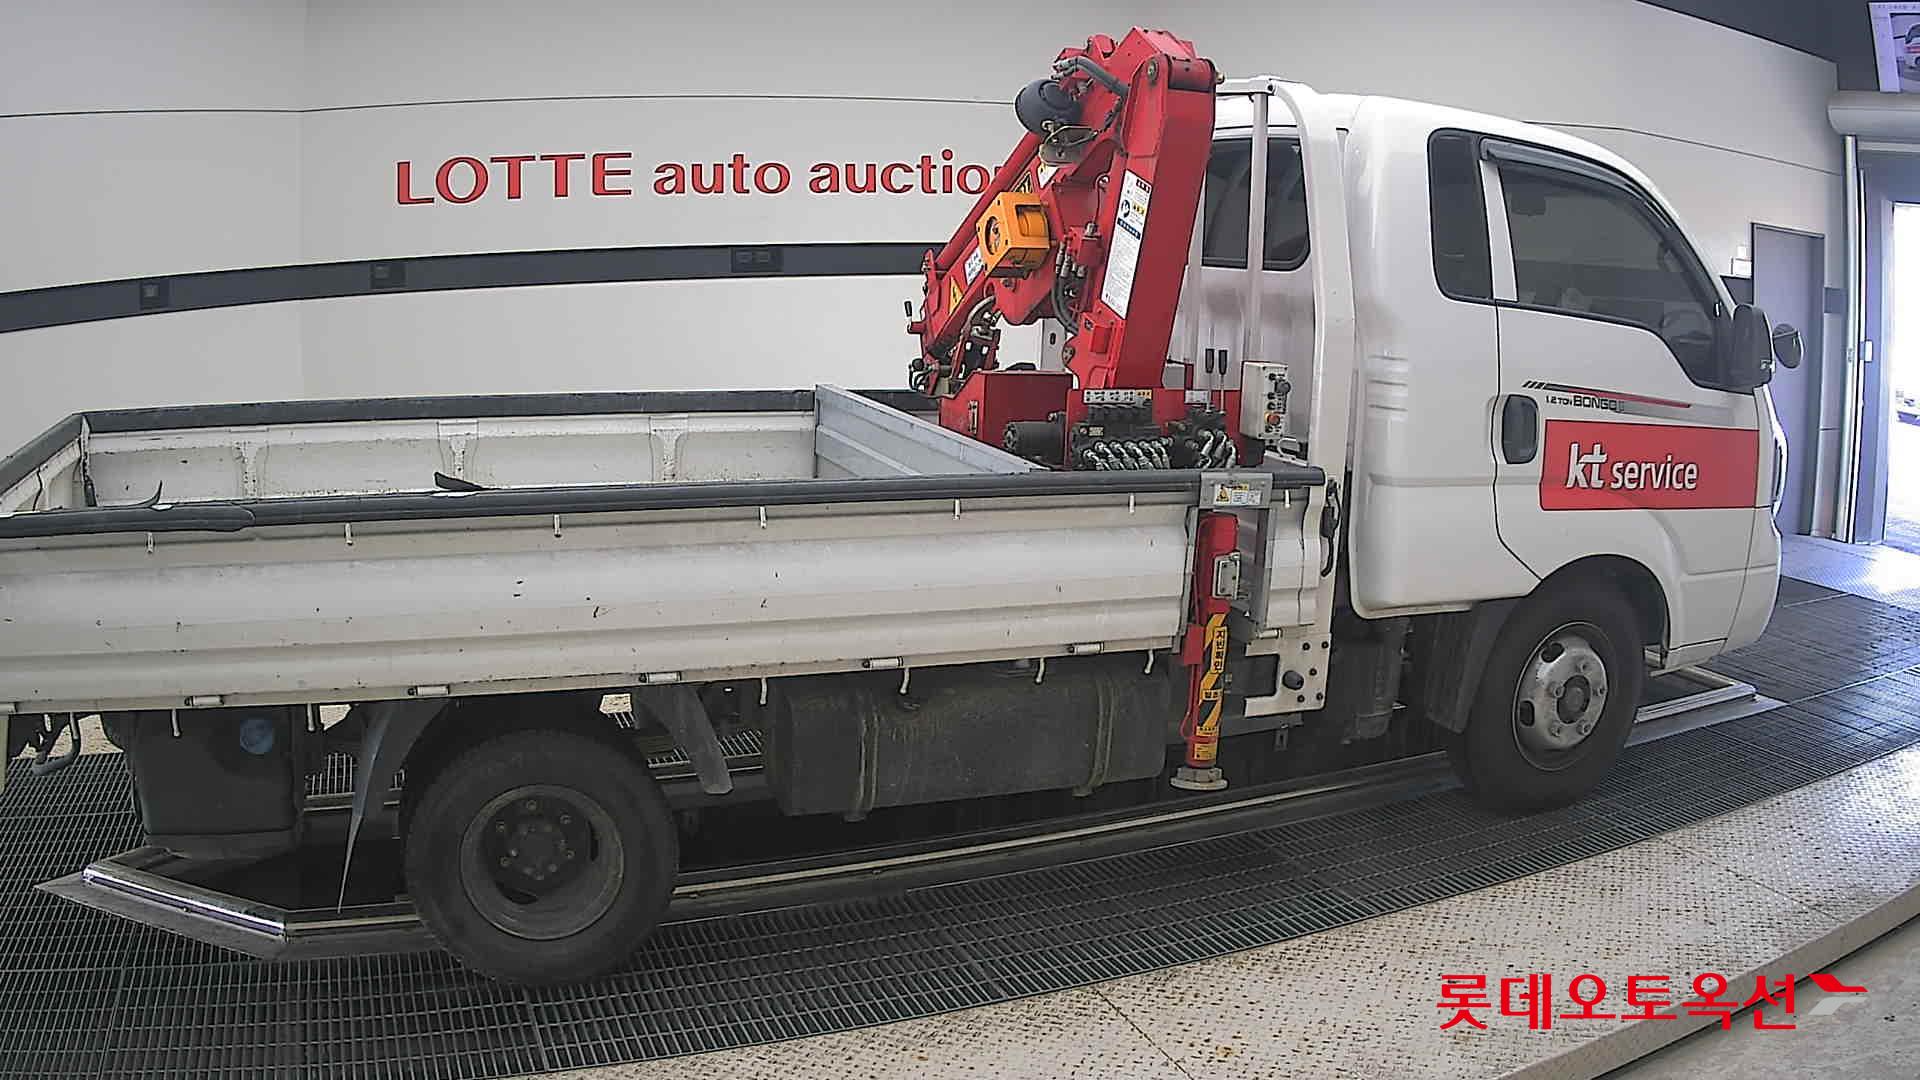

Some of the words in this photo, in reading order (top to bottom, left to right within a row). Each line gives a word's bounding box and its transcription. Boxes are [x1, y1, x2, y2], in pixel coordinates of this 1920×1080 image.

[397, 152, 632, 204] LOTTE
[653, 153, 791, 195] auto
[809, 149, 1003, 194] auctio
[1567, 442, 1608, 488] kt
[1610, 455, 1698, 490] service
